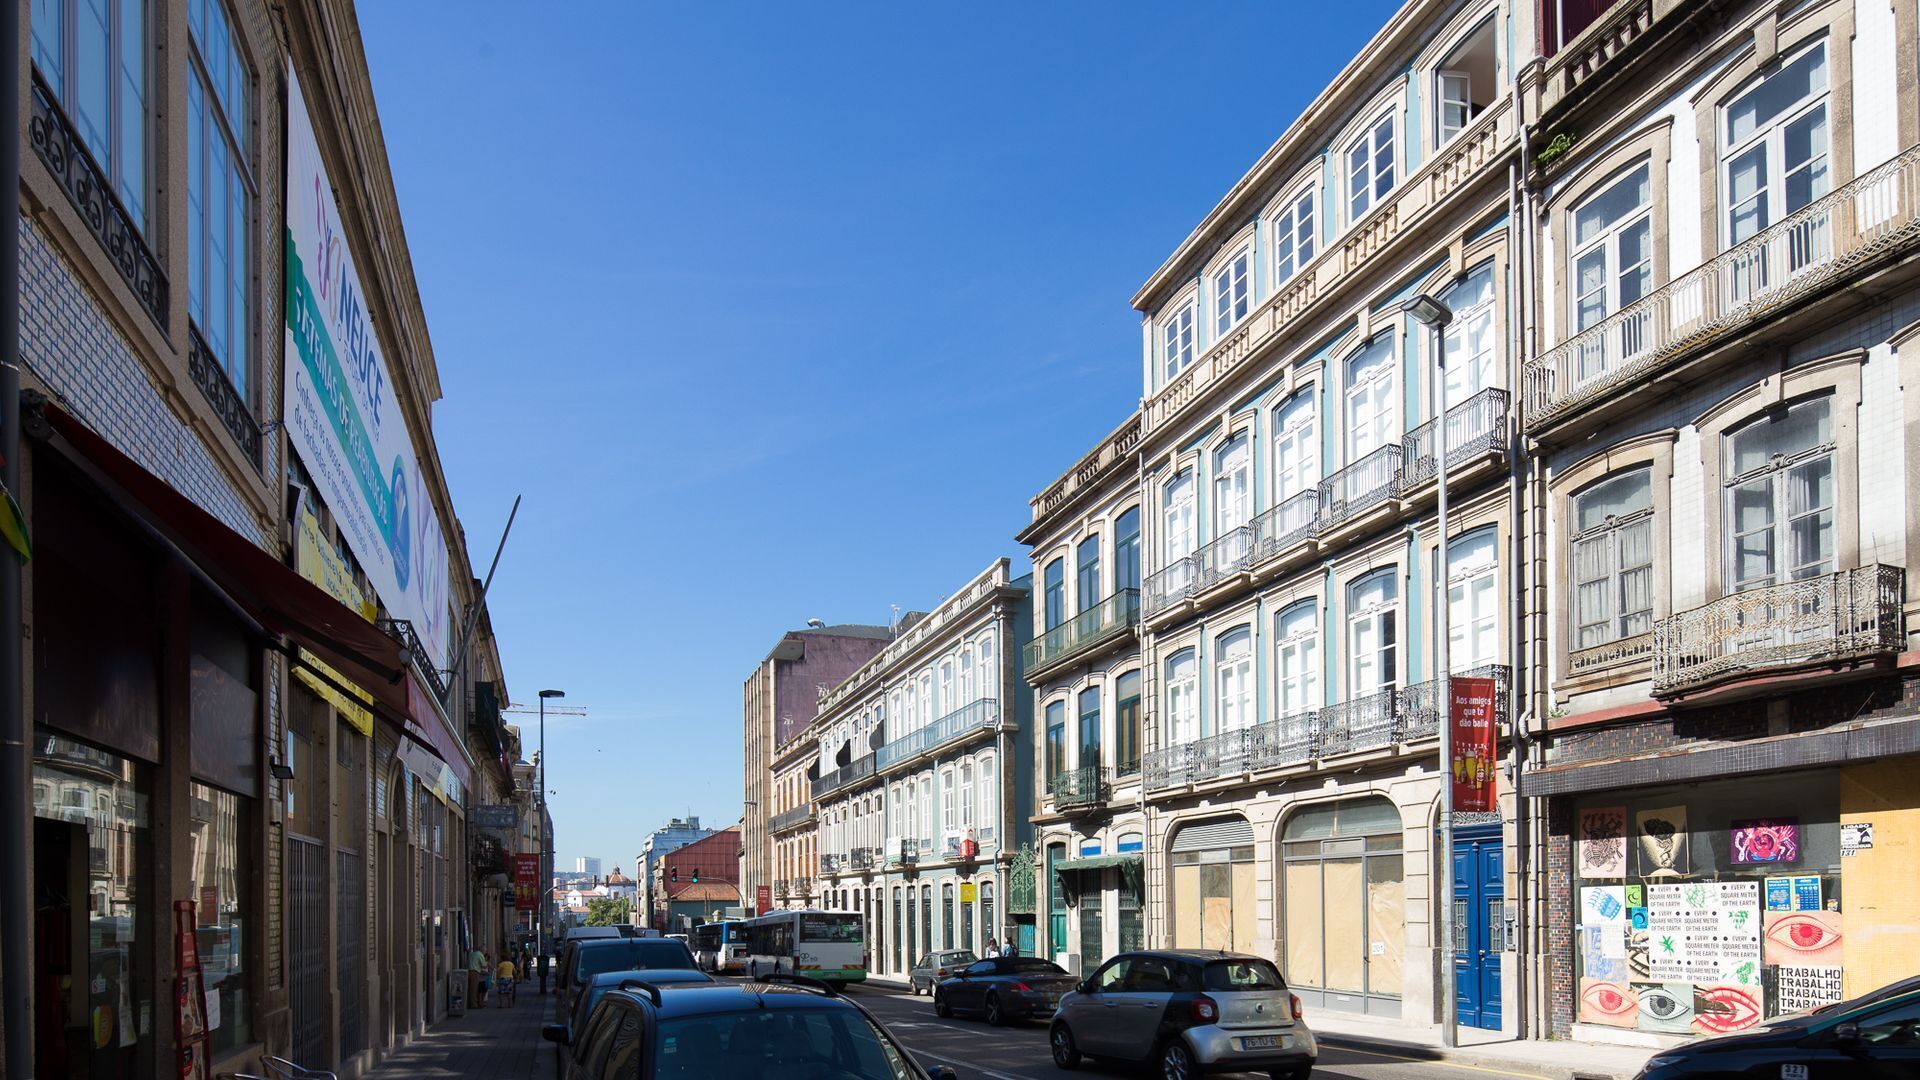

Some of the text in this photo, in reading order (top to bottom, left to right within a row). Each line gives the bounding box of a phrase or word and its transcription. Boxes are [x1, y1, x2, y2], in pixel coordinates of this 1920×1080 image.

[340, 262, 383, 427] NEUCE
[296, 286, 338, 408] SISTEMAS
[340, 392, 350, 434] DE
[319, 423, 326, 444] os
[294, 402, 303, 431] de
[303, 418, 327, 478] fachadas
[1456, 696, 1492, 707] Aos amigos
[1464, 707, 1484, 718] que te
[1780, 968, 1840, 979] TRABALHO
[1780, 978, 1841, 990] TRABALHO
[1780, 988, 1841, 1000] TRABALHO
[1784, 1064, 1805, 1074] 327
